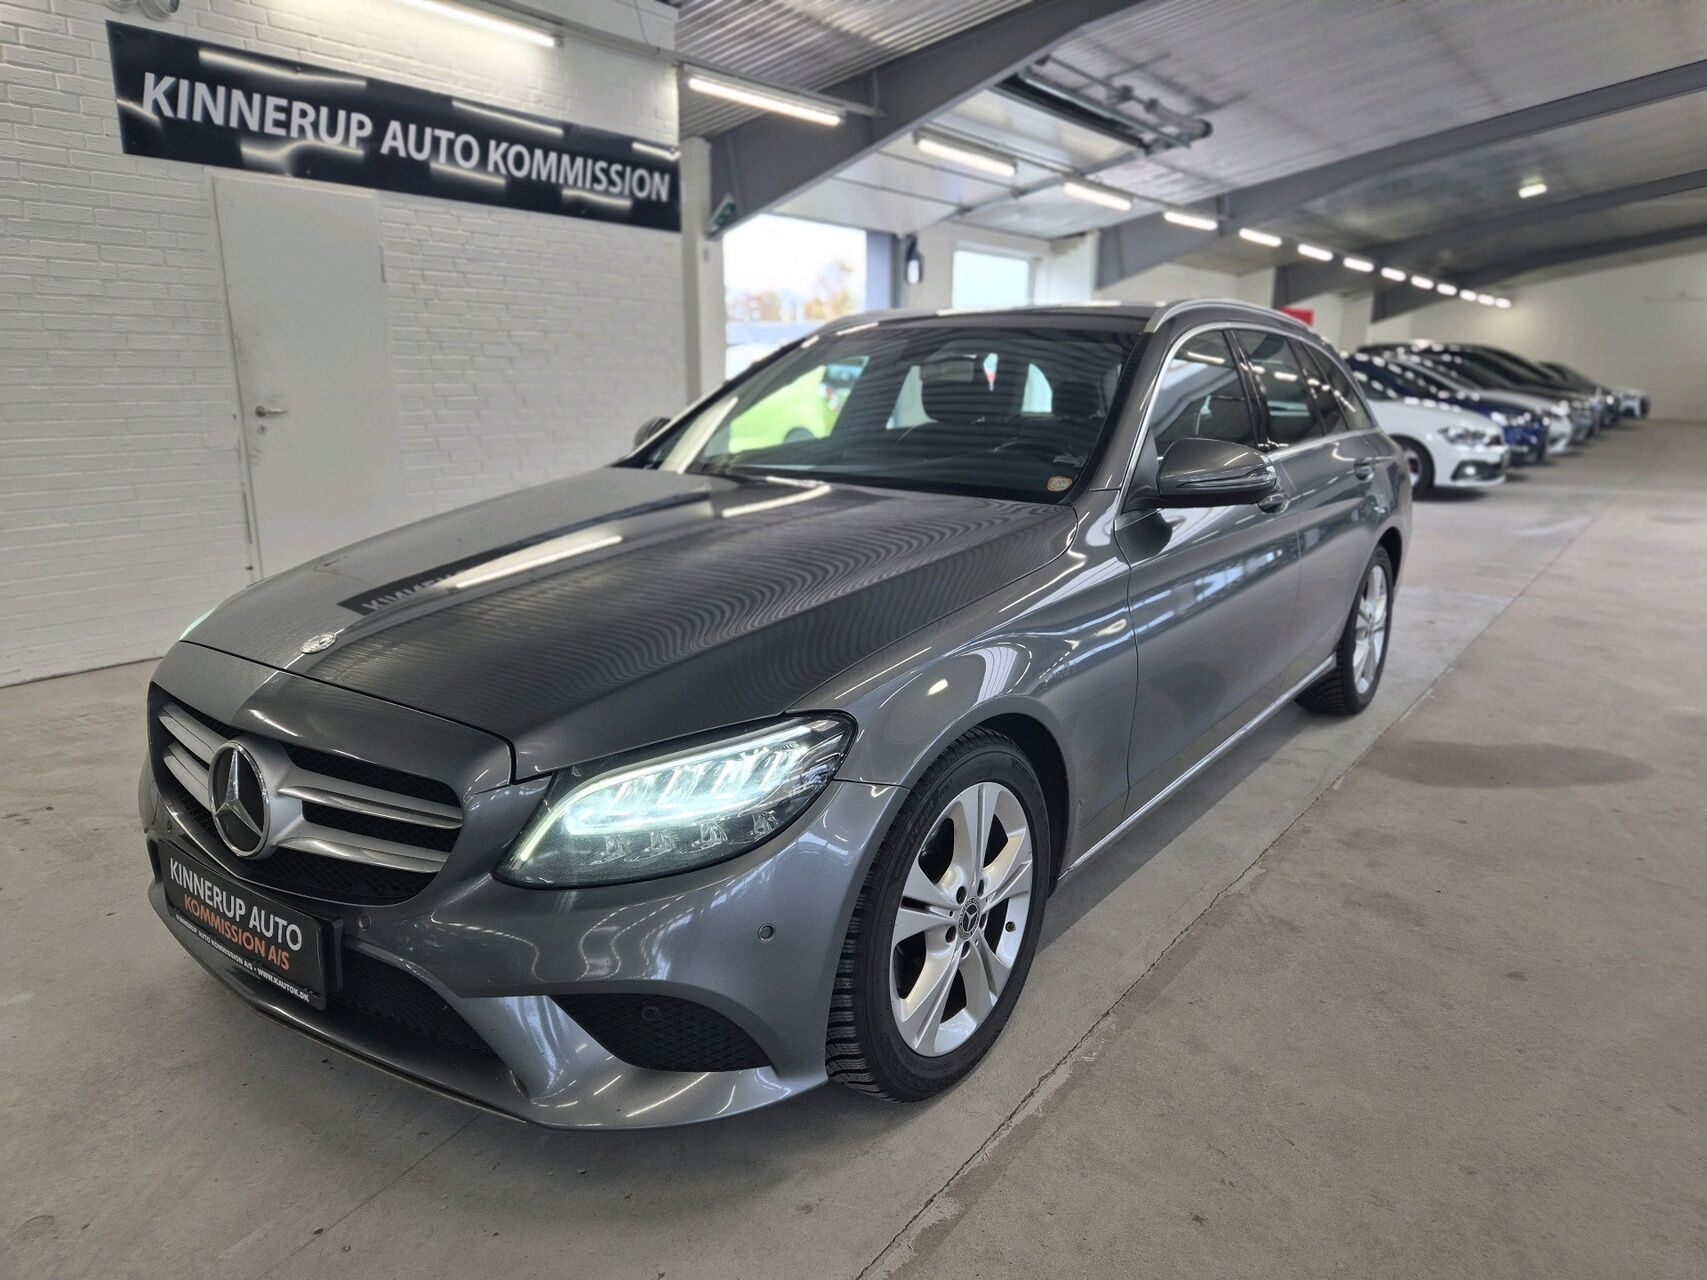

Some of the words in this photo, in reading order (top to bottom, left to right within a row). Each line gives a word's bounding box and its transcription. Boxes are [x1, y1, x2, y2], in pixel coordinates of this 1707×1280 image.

[142, 71, 373, 149] KINNERUP
[380, 120, 480, 169] AUTO
[487, 139, 671, 202] KOMMISSION
[170, 858, 246, 922] KINNERUP
[249, 906, 303, 951] AUTO
[184, 894, 266, 958] KOMMISSION
